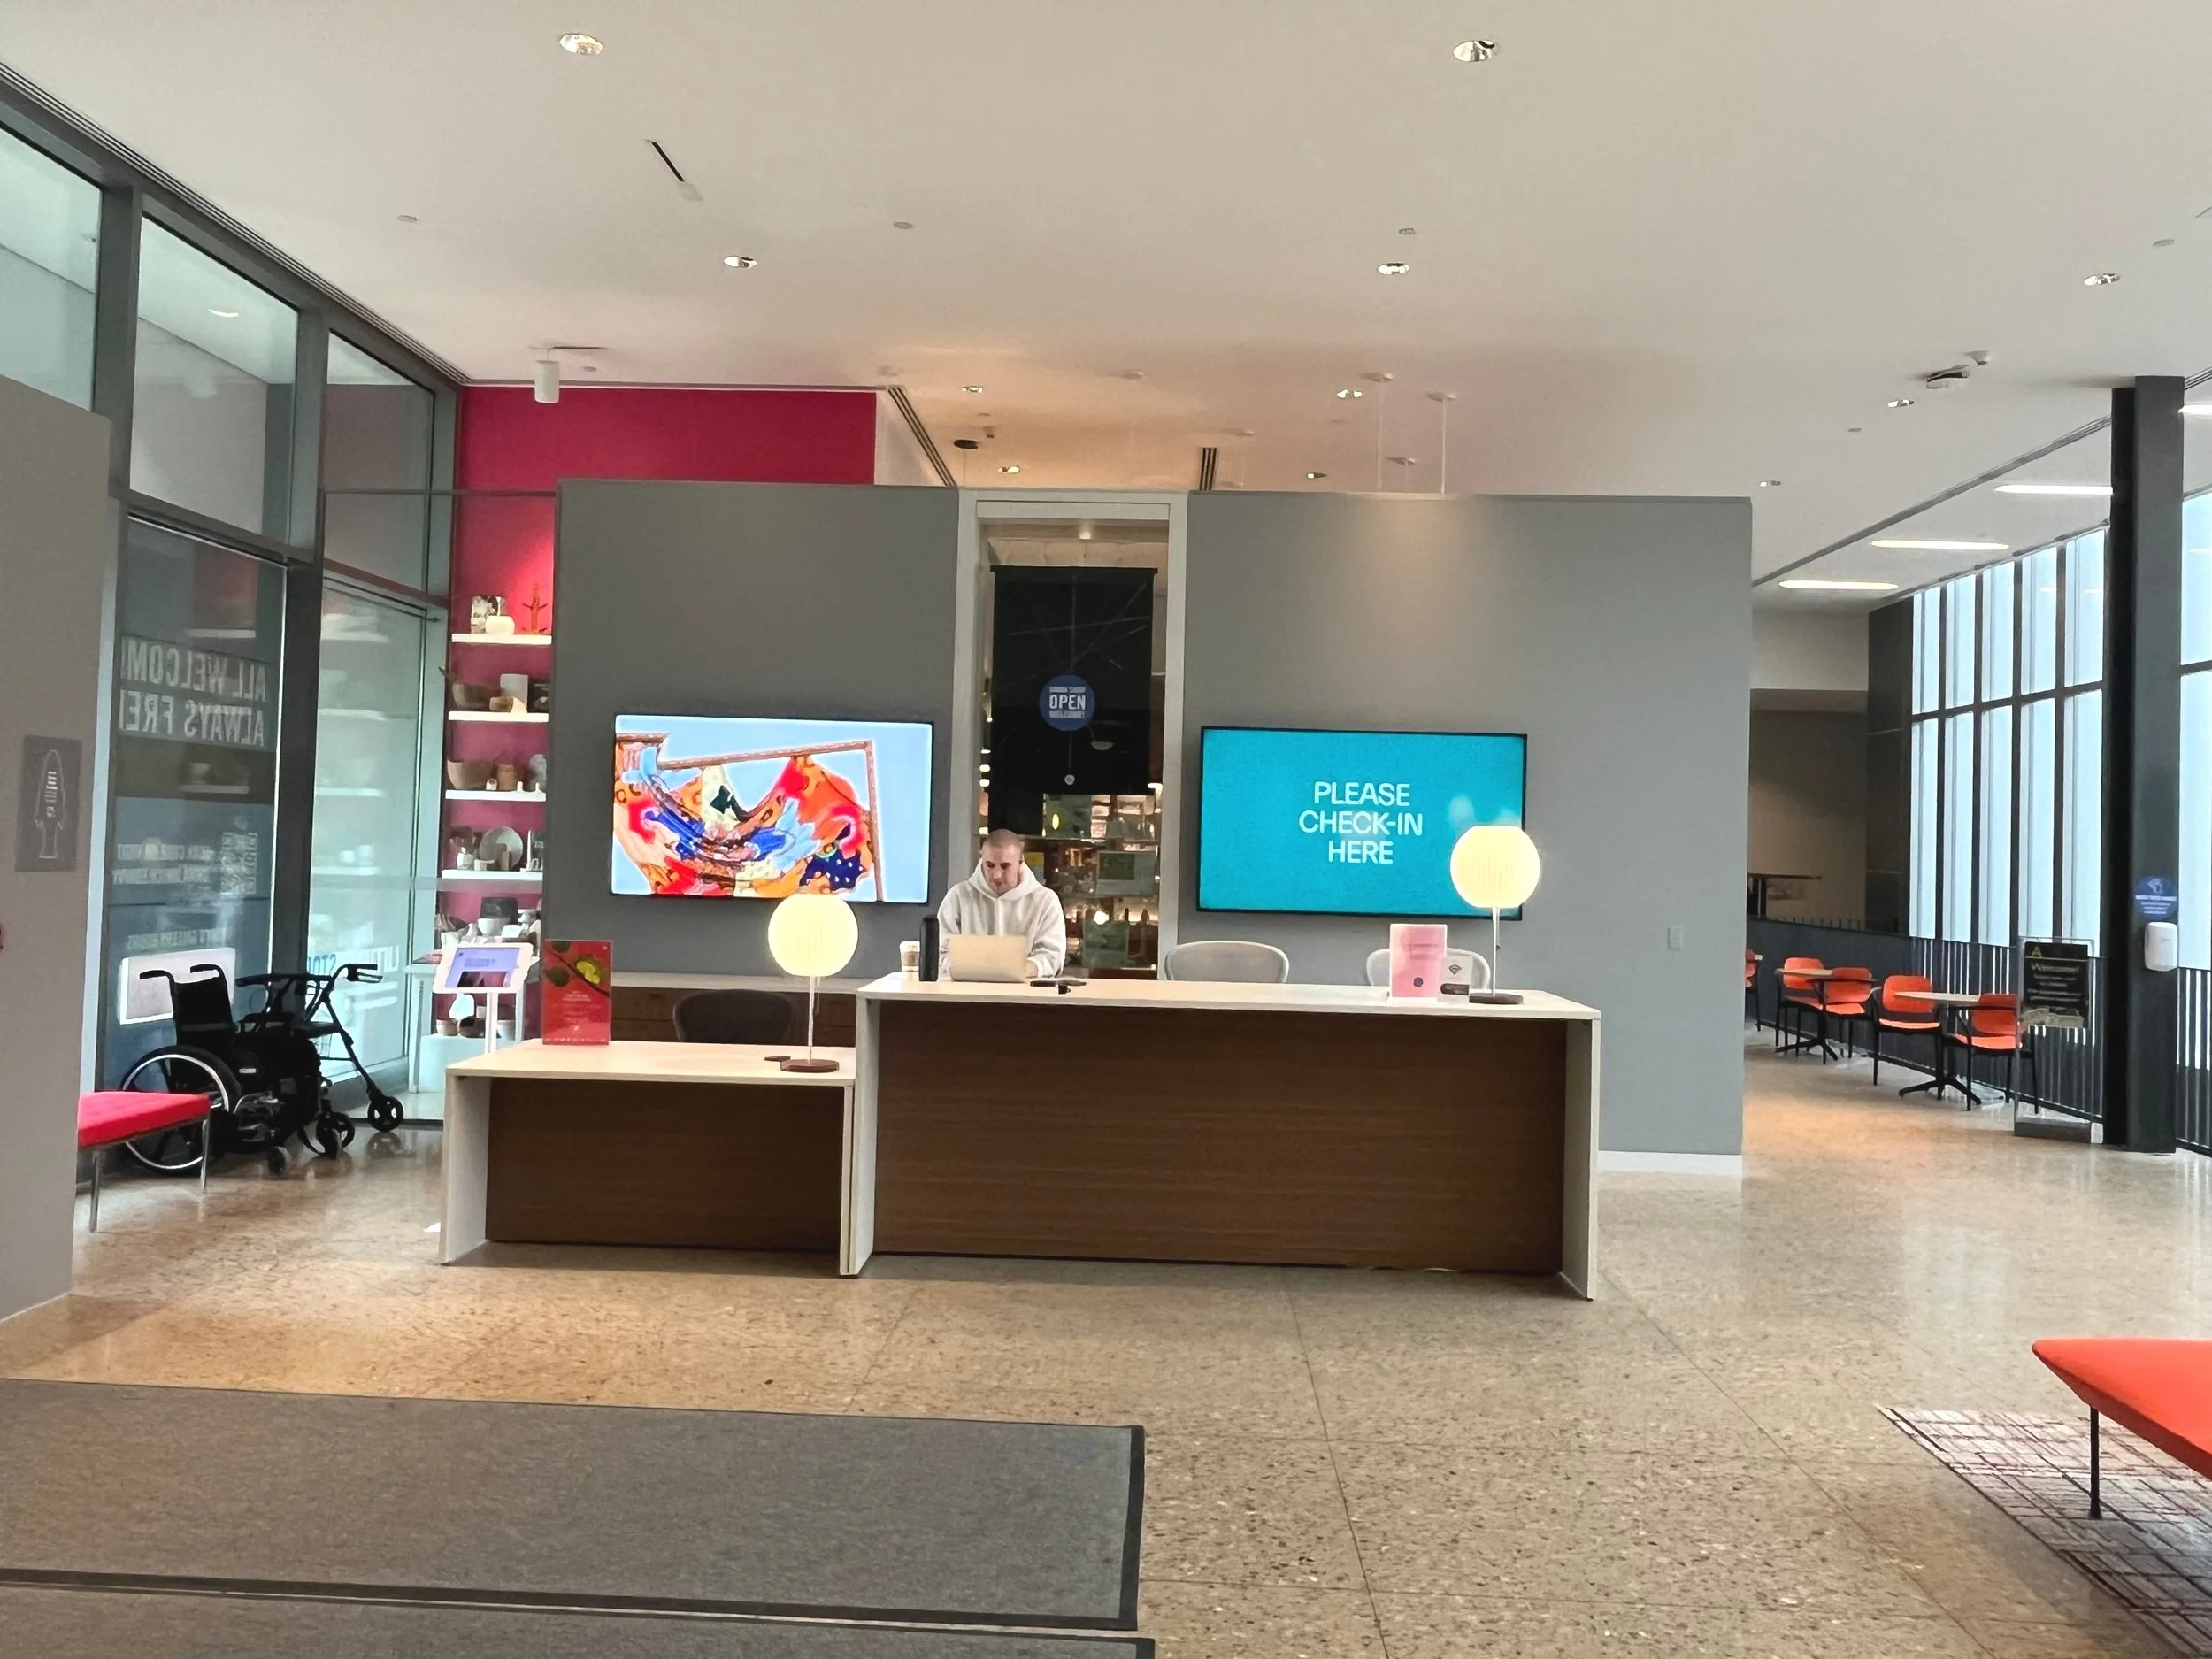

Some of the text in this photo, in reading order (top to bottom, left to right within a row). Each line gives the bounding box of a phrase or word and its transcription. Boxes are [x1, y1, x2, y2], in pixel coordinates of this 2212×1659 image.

[1049, 695, 1086, 710] OPEN
[1314, 780, 1411, 807] PLEASE
[1298, 810, 1424, 836] CHECK-IN
[1328, 841, 1394, 864] HERE
